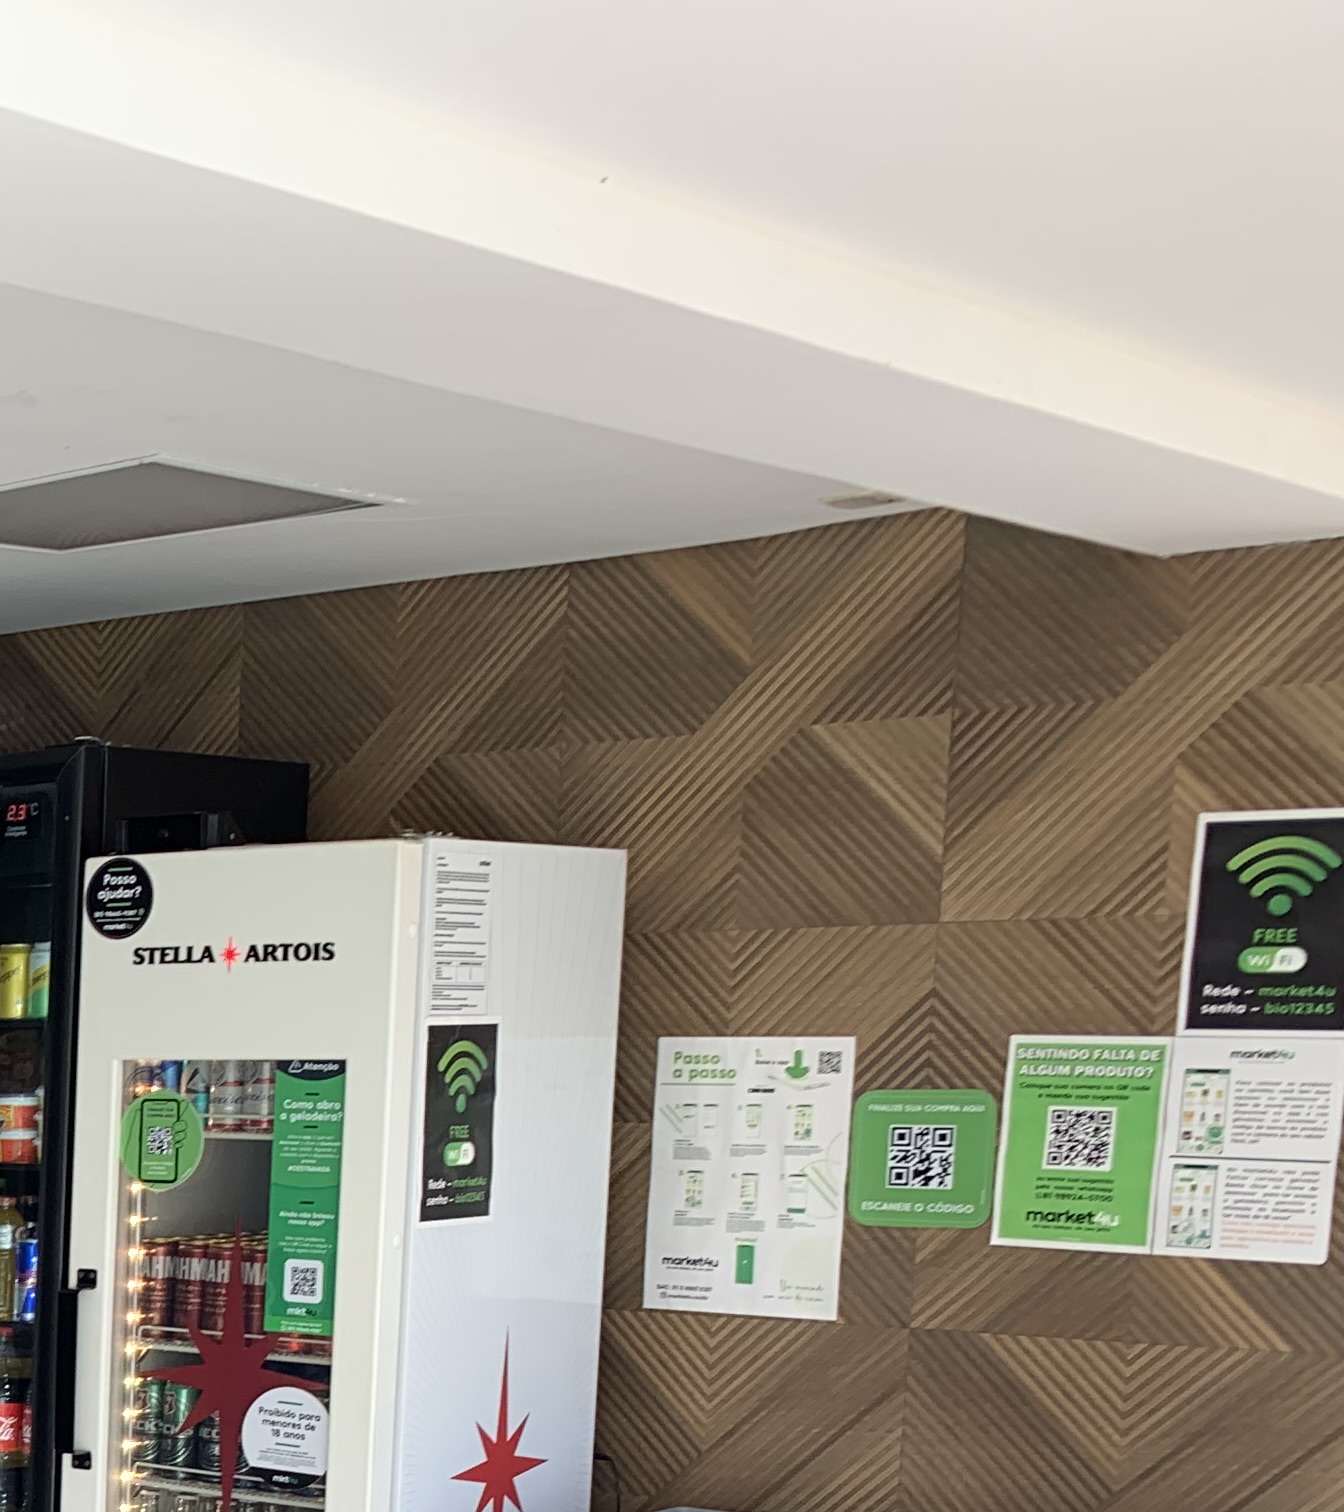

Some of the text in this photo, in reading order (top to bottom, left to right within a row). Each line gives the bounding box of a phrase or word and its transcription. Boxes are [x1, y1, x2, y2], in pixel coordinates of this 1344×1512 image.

[103, 874, 137, 887] Posso
[97, 886, 142, 902] ajudar?
[1252, 928, 1298, 944] FREE
[133, 942, 336, 966] STELLA ARTOIS
[1201, 984, 1241, 998] Rede
[1257, 984, 1337, 998] market4u
[1199, 1001, 1247, 1015] senha
[673, 1051, 721, 1065] Passo
[1016, 1047, 1162, 1062] SENTINDO FALTA DE
[672, 1068, 737, 1082] a passo
[1019, 1064, 1154, 1078] ALGUM PRODUTO?
[282, 1099, 342, 1110] Como abro
[861, 1201, 975, 1214] ESCANEIE O CÓDIGO
[1025, 1209, 1120, 1227] market4u
[258, 1406, 321, 1421] Proibido para
[261, 1419, 316, 1432] menores de
[271, 1429, 306, 1441] 18 anos
